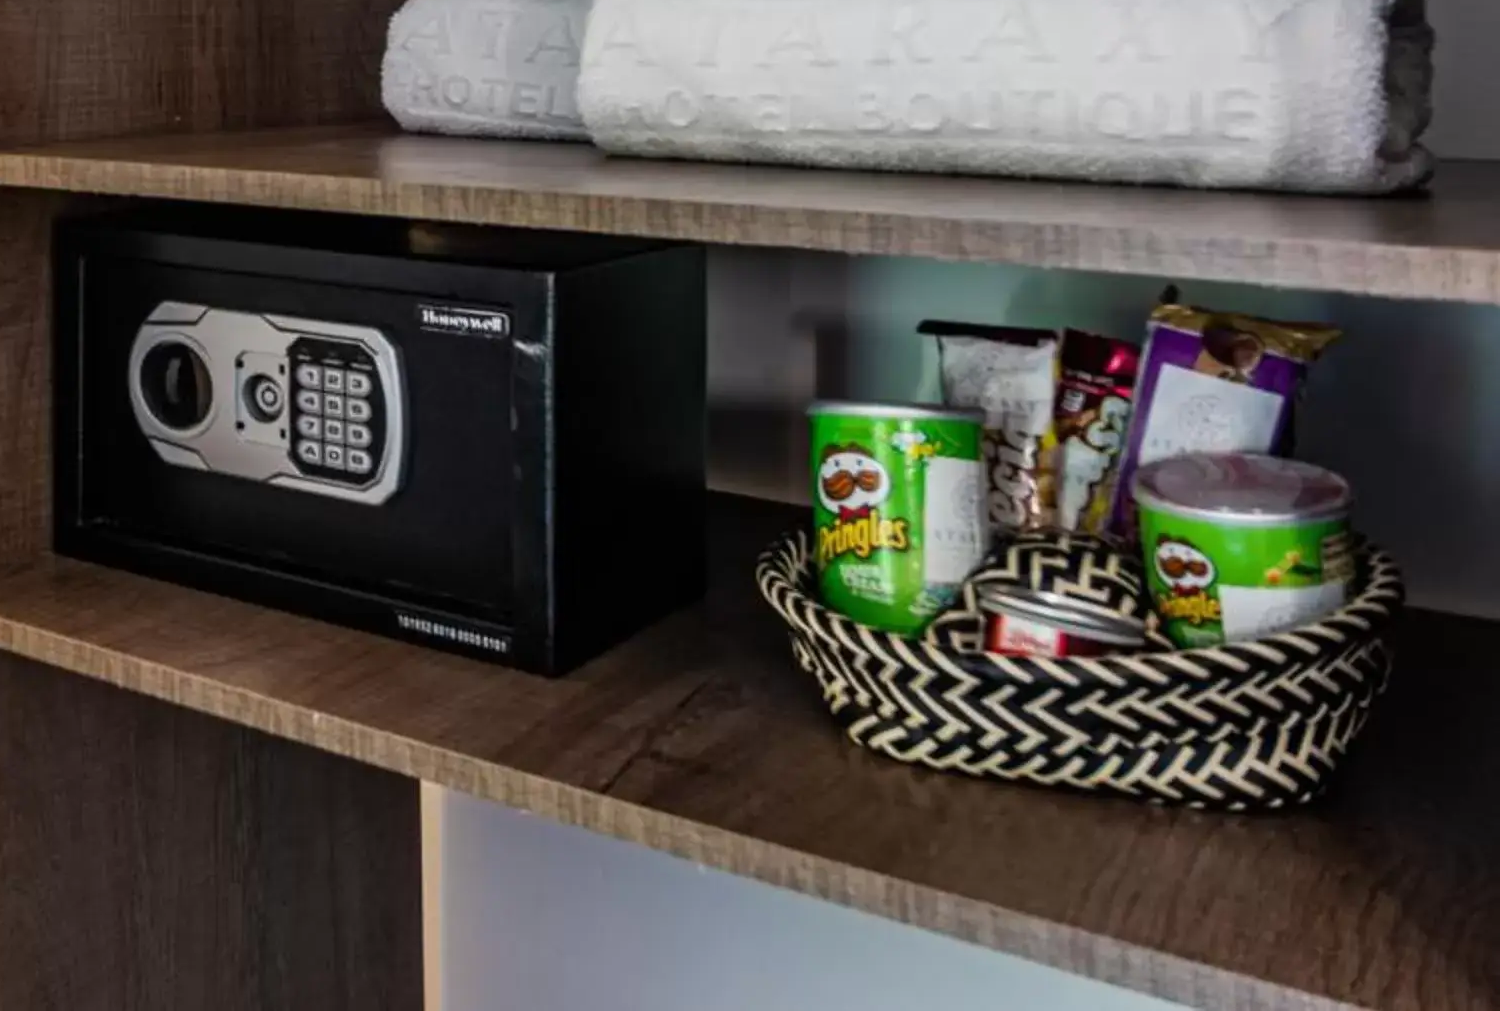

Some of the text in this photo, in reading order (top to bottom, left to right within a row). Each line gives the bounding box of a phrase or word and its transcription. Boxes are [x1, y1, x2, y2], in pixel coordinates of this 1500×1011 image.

[854, 88, 1257, 141] BOUTIQUE
[421, 309, 503, 333] Honeywell
[817, 510, 908, 566] Pringles
